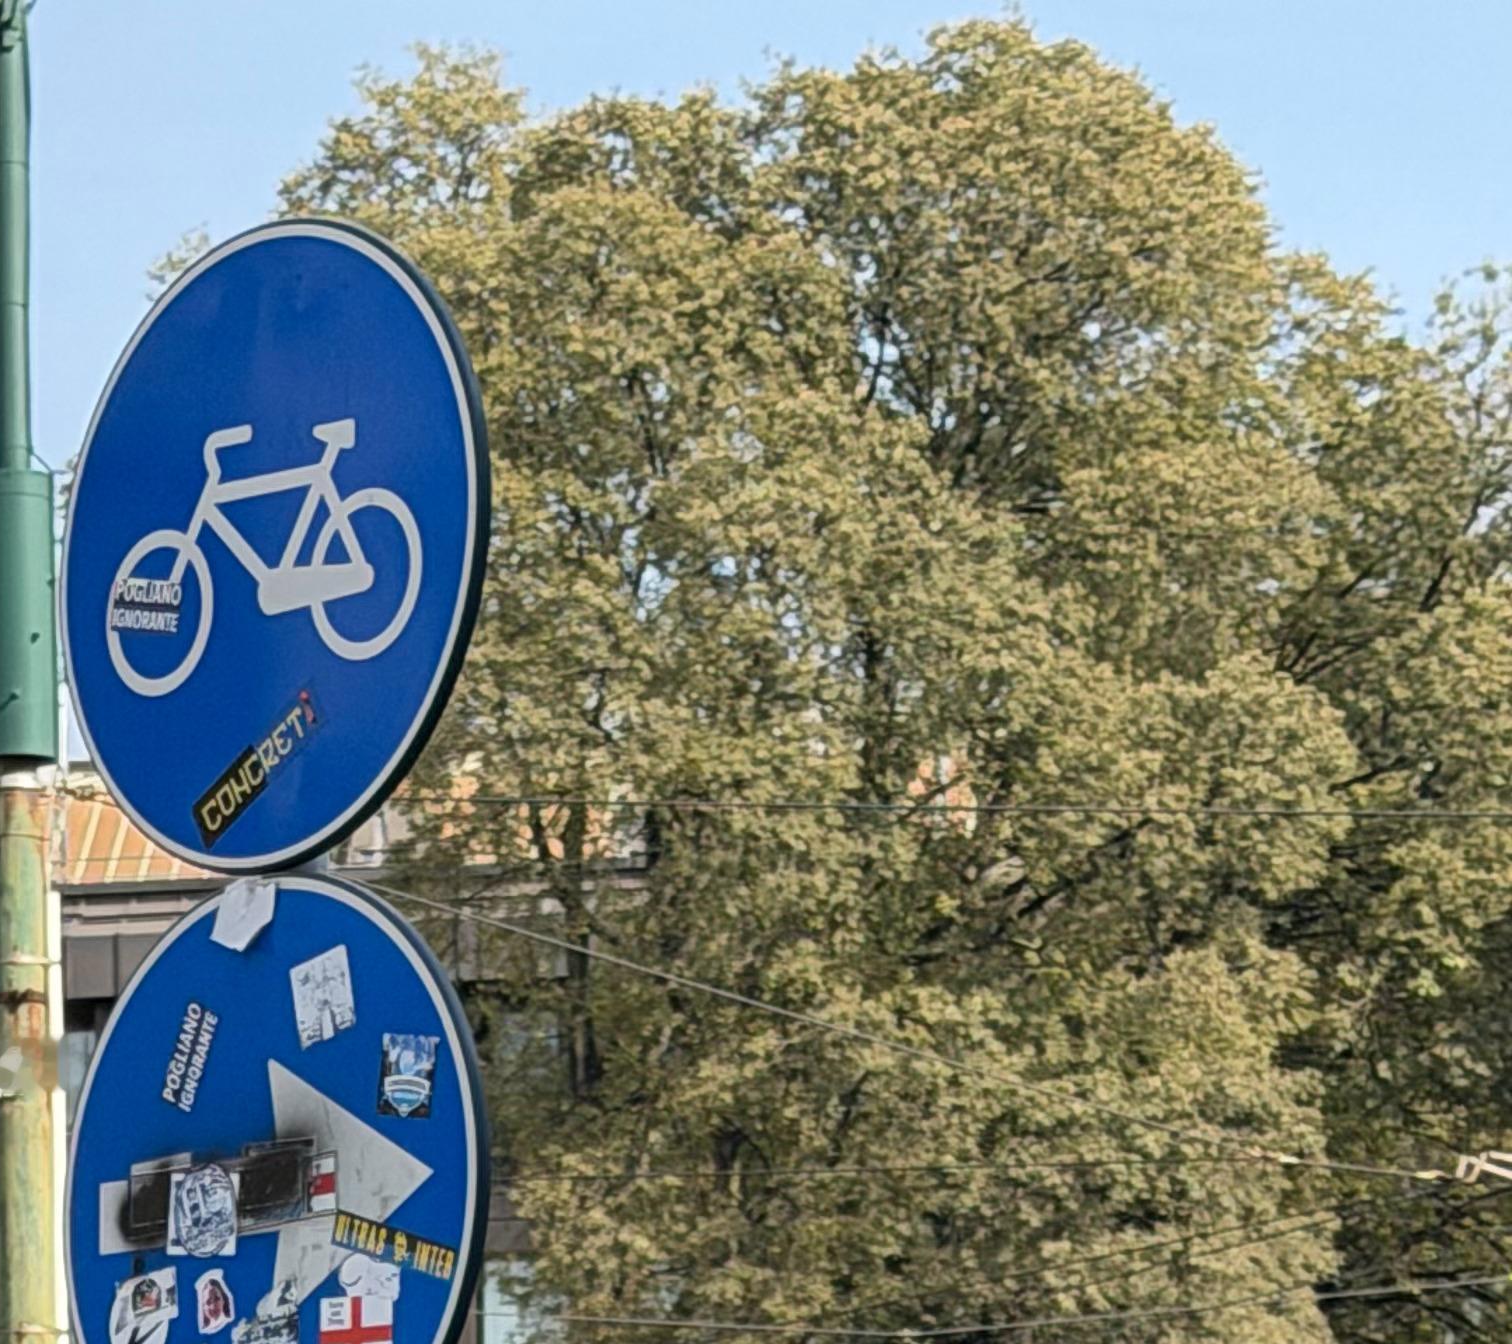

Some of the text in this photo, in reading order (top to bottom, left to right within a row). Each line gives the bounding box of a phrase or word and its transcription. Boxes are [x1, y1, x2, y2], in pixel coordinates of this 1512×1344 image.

[161, 1002, 202, 1103] POGLIANO
[177, 1010, 219, 1113] IGNORANTE
[334, 1214, 455, 1281] ULTRAS INTER
